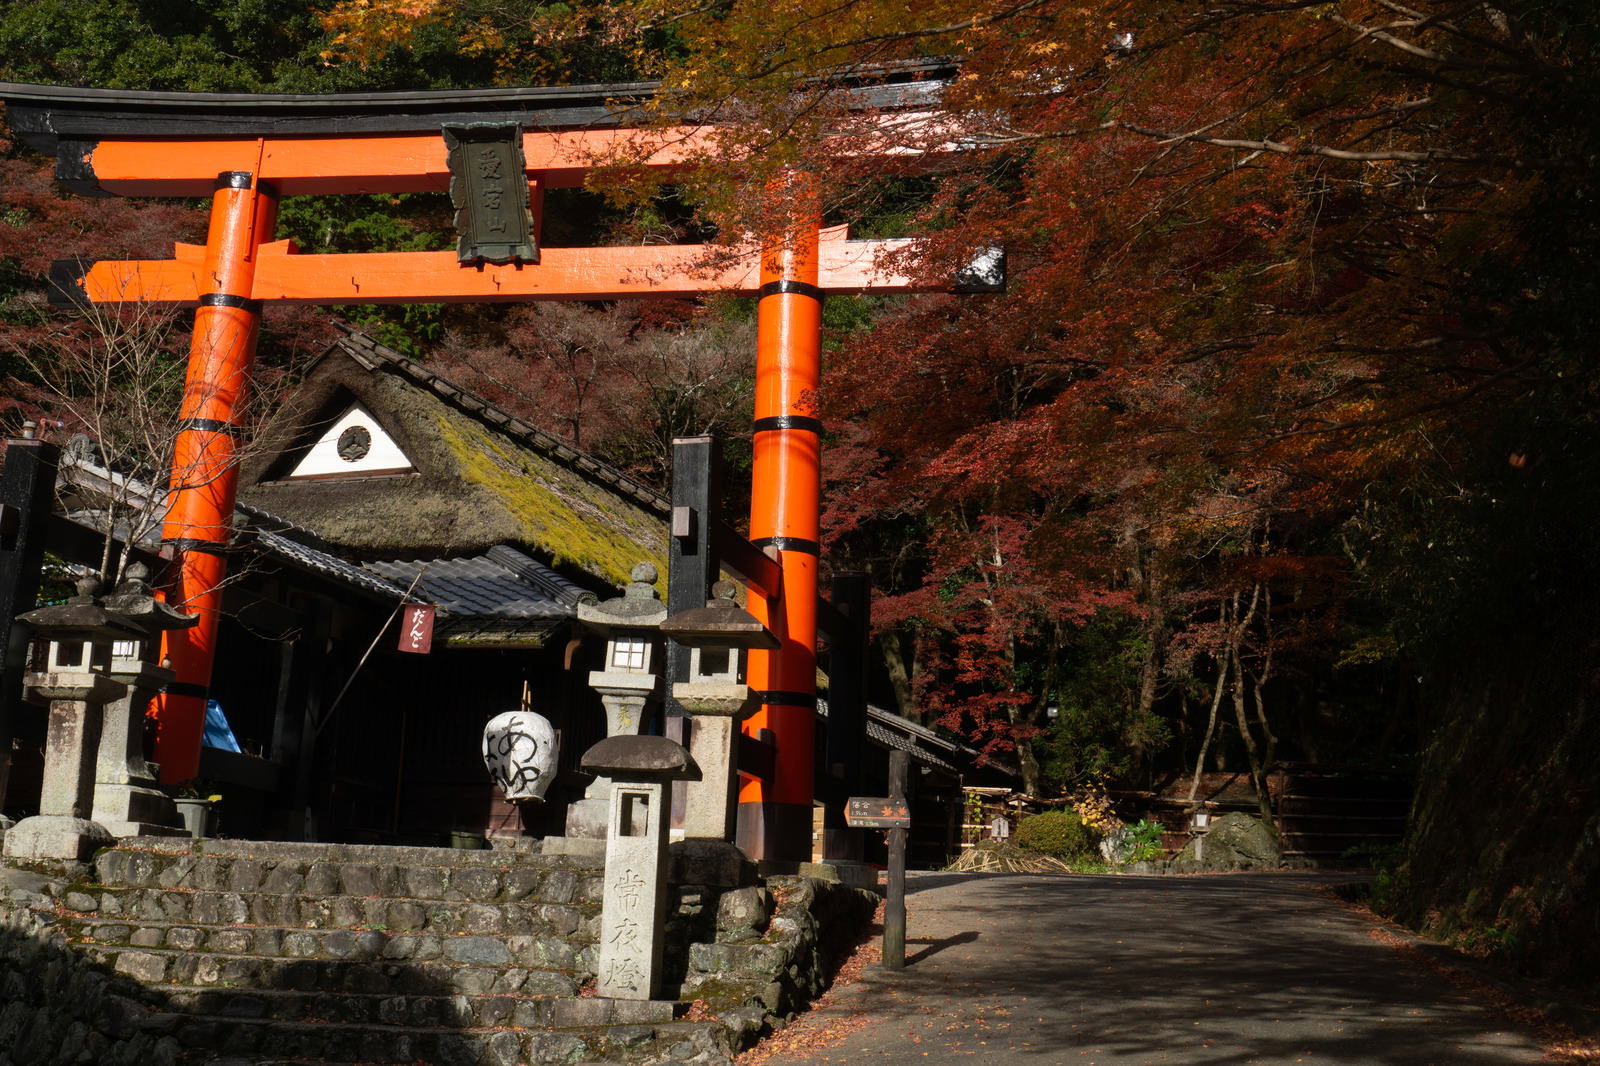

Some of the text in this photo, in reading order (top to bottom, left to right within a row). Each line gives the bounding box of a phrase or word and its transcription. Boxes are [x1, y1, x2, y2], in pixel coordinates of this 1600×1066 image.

[410, 608, 427, 648] だんご
[498, 716, 541, 795] あゆ
[604, 868, 647, 993] 常夜燈
